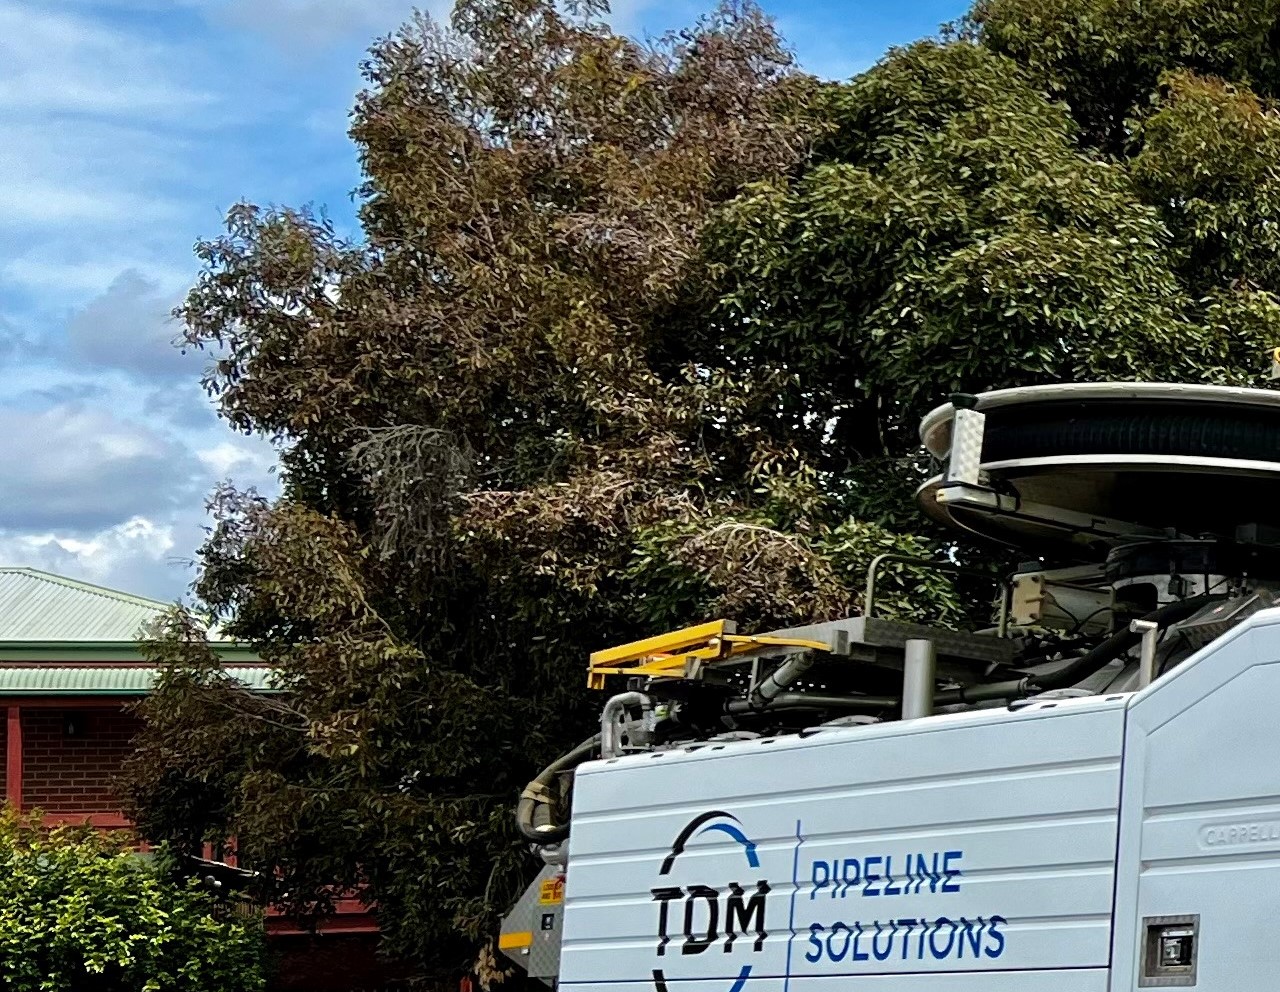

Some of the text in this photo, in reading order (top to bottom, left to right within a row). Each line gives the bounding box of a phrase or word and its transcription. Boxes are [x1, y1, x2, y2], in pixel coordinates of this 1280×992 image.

[810, 850, 964, 900] PIPELINE
[651, 880, 771, 957] TDM
[804, 915, 1008, 964] SOLUTIONS
